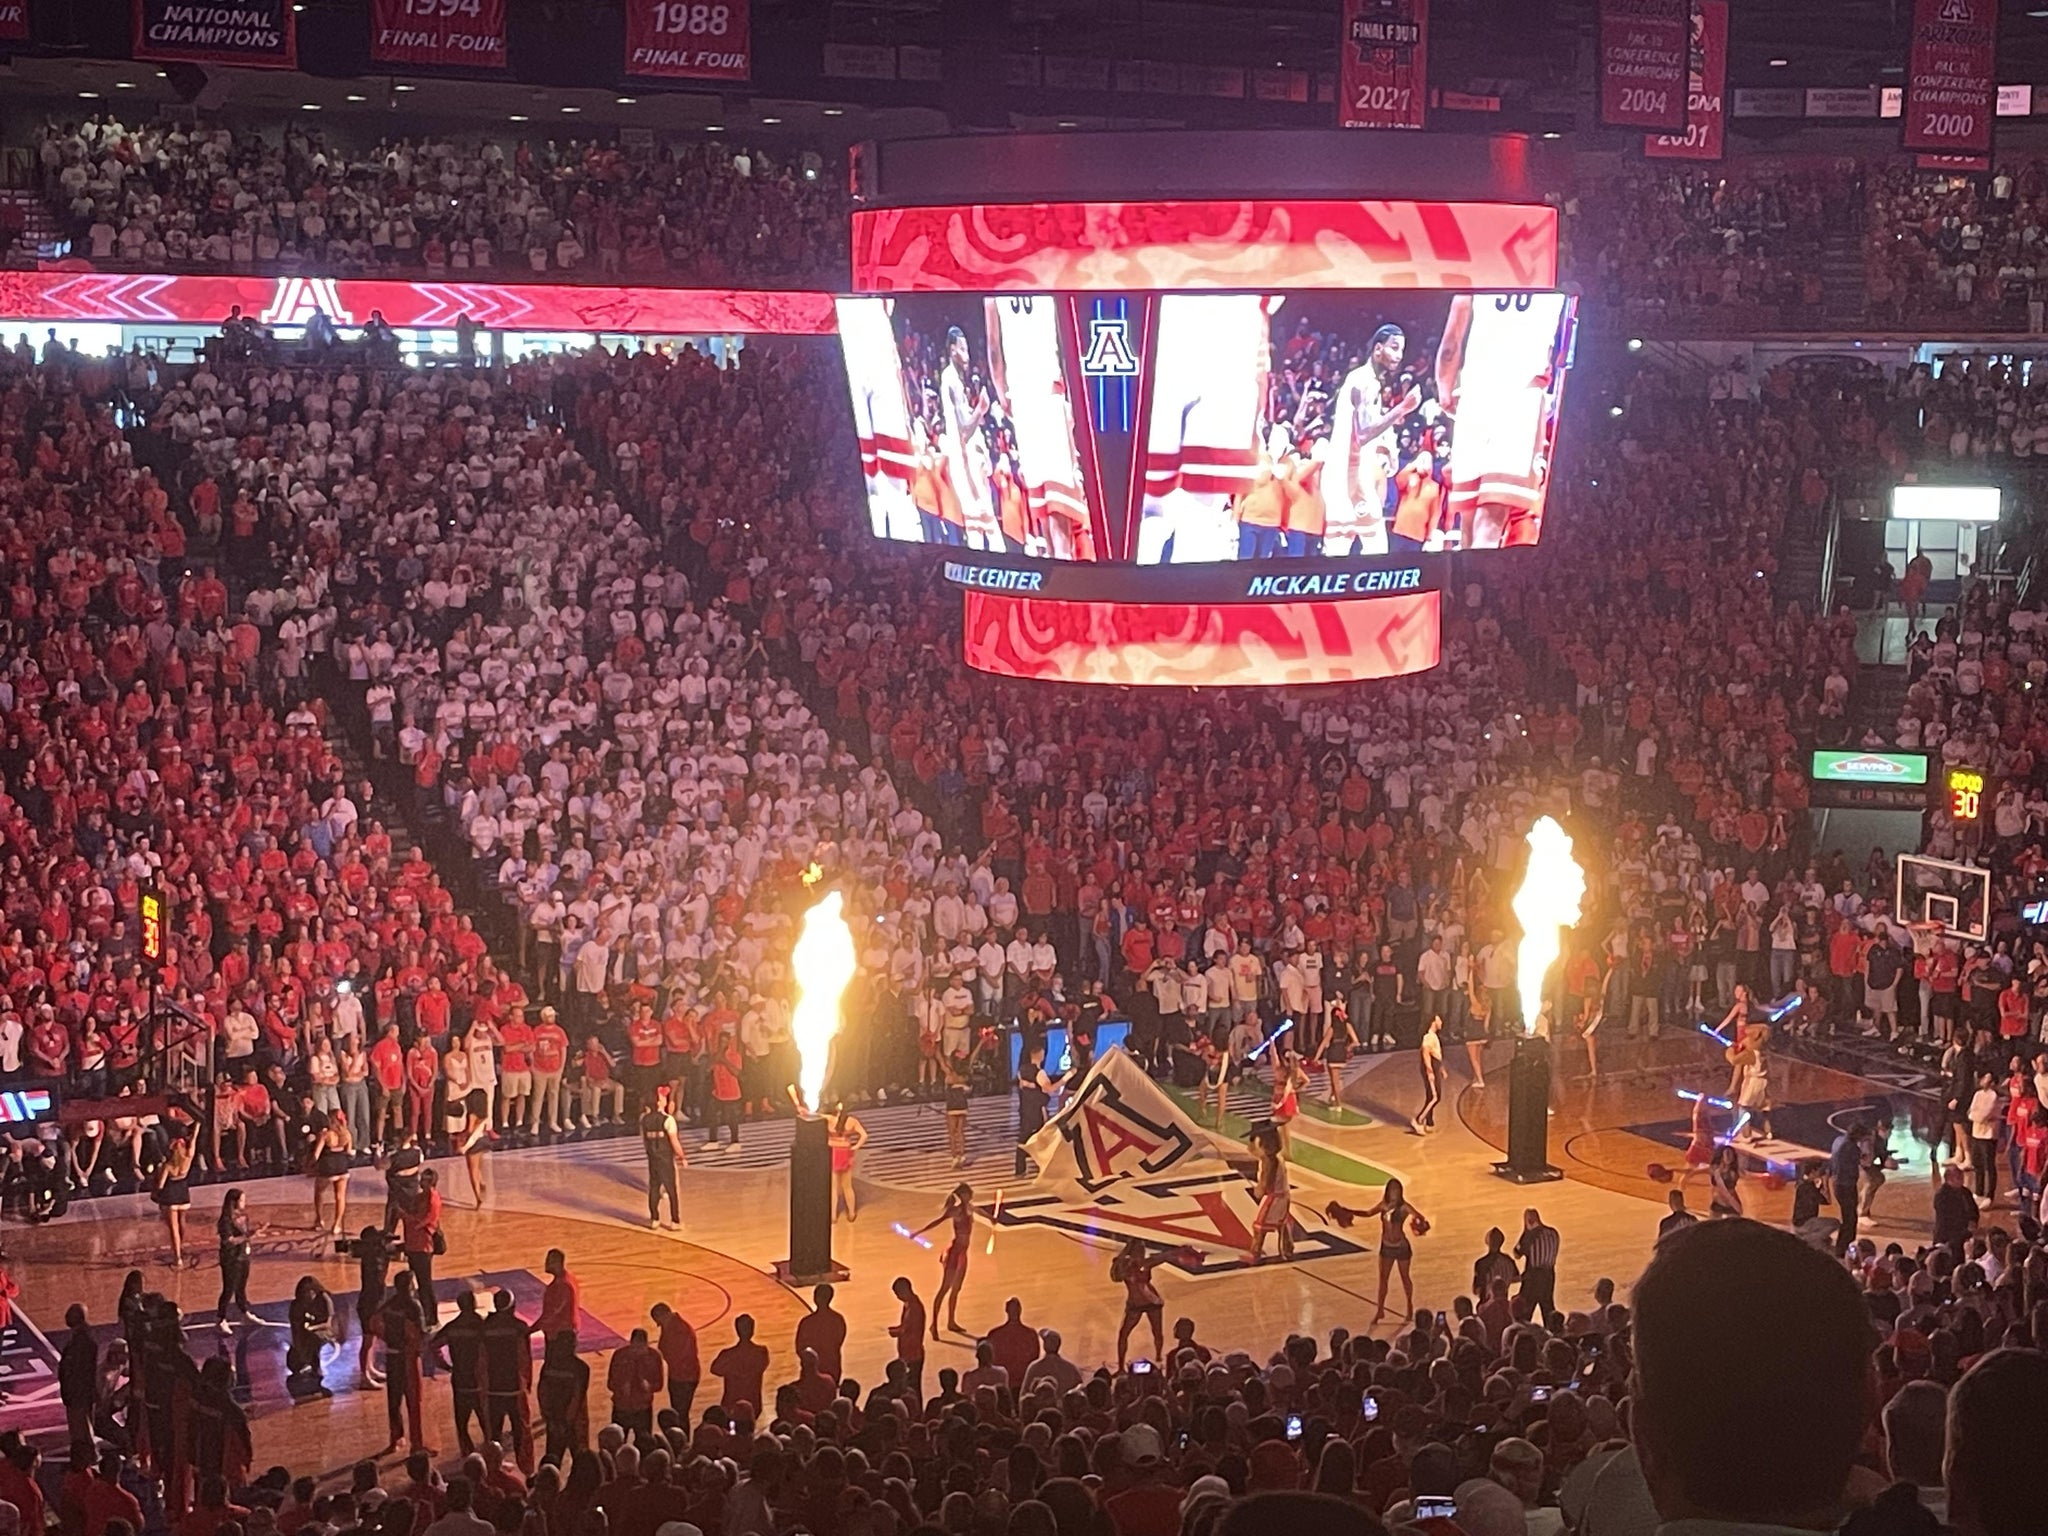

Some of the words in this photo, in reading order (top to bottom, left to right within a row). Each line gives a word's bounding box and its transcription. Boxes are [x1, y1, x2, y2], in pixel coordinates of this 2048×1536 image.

[164, 6, 271, 27] NATIONAL
[653, 3, 728, 35] 1988
[149, 24, 281, 47] CHAMPIONS
[379, 29, 438, 48] FINAL
[446, 33, 502, 52] FOUR
[1353, 22, 1384, 40] FINAL
[633, 48, 689, 66] FINAL
[695, 52, 745, 69] FOUR
[1607, 47, 1681, 64] CONFERENCE
[1607, 63, 1681, 80] CHAMPIONS
[1914, 75, 1988, 90] CONFERENCE
[1355, 85, 1411, 111] 2021
[1620, 88, 1668, 114] 2004
[1913, 89, 1987, 105] CHAMPIONS
[1922, 114, 1974, 136] 2000
[1082, 320, 1139, 375] A
[978, 567, 1042, 591] CENTER
[1247, 574, 1350, 596] MCKALE
[1353, 569, 1421, 592] CENTER
[1953, 790, 1979, 819] 30
